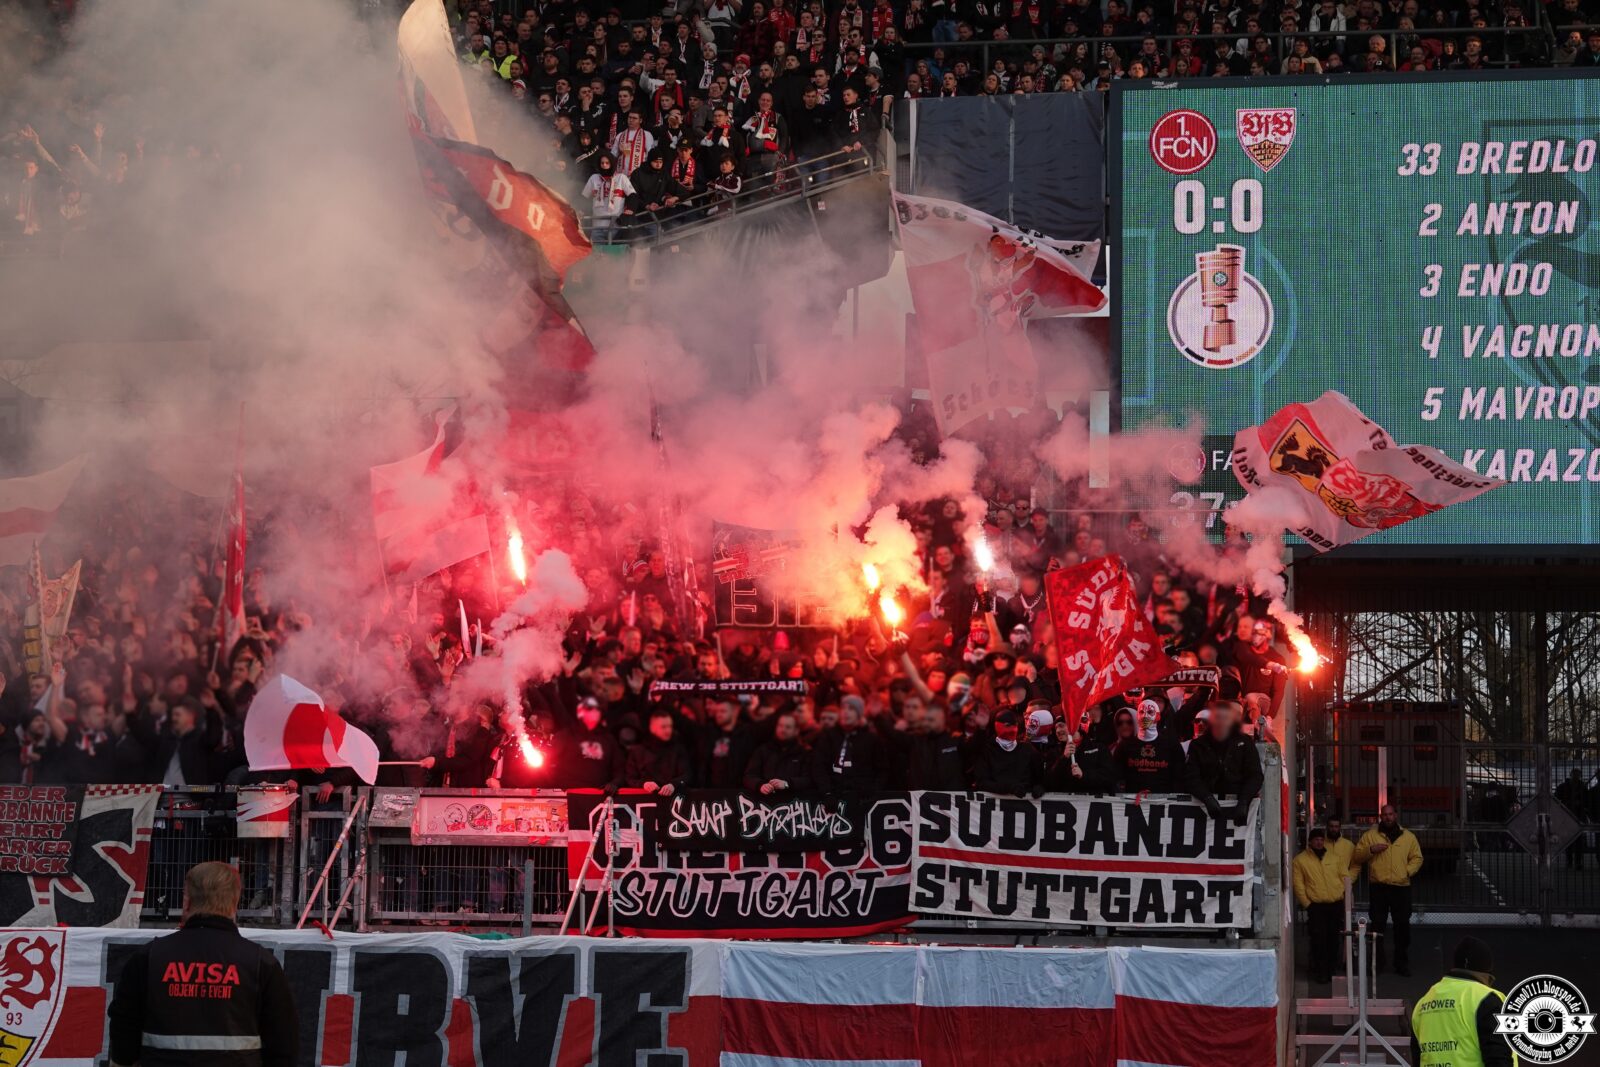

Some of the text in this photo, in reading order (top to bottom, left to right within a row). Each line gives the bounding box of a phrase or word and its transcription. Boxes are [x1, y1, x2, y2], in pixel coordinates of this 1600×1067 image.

[1159, 136, 1208, 158] FCN
[1397, 139, 1596, 176] 33 BREDLO
[1174, 178, 1264, 234] 0:0
[1418, 201, 1580, 236] 2 ANTON
[1420, 262, 1553, 297] 3 ENDO
[1421, 323, 1600, 358] 4 VAGNOM
[1421, 386, 1600, 420] 5 MAVROP
[919, 791, 1246, 860] SÜDBANDE
[613, 869, 886, 919] STUTTGART
[914, 863, 1244, 924] STUTTGART
[161, 962, 240, 985] AVISA
[168, 983, 199, 998] OBJEKT
[208, 985, 232, 999] EVENT
[6, 1012, 23, 1026] 93
[1428, 1040, 1458, 1053] SECURITY
